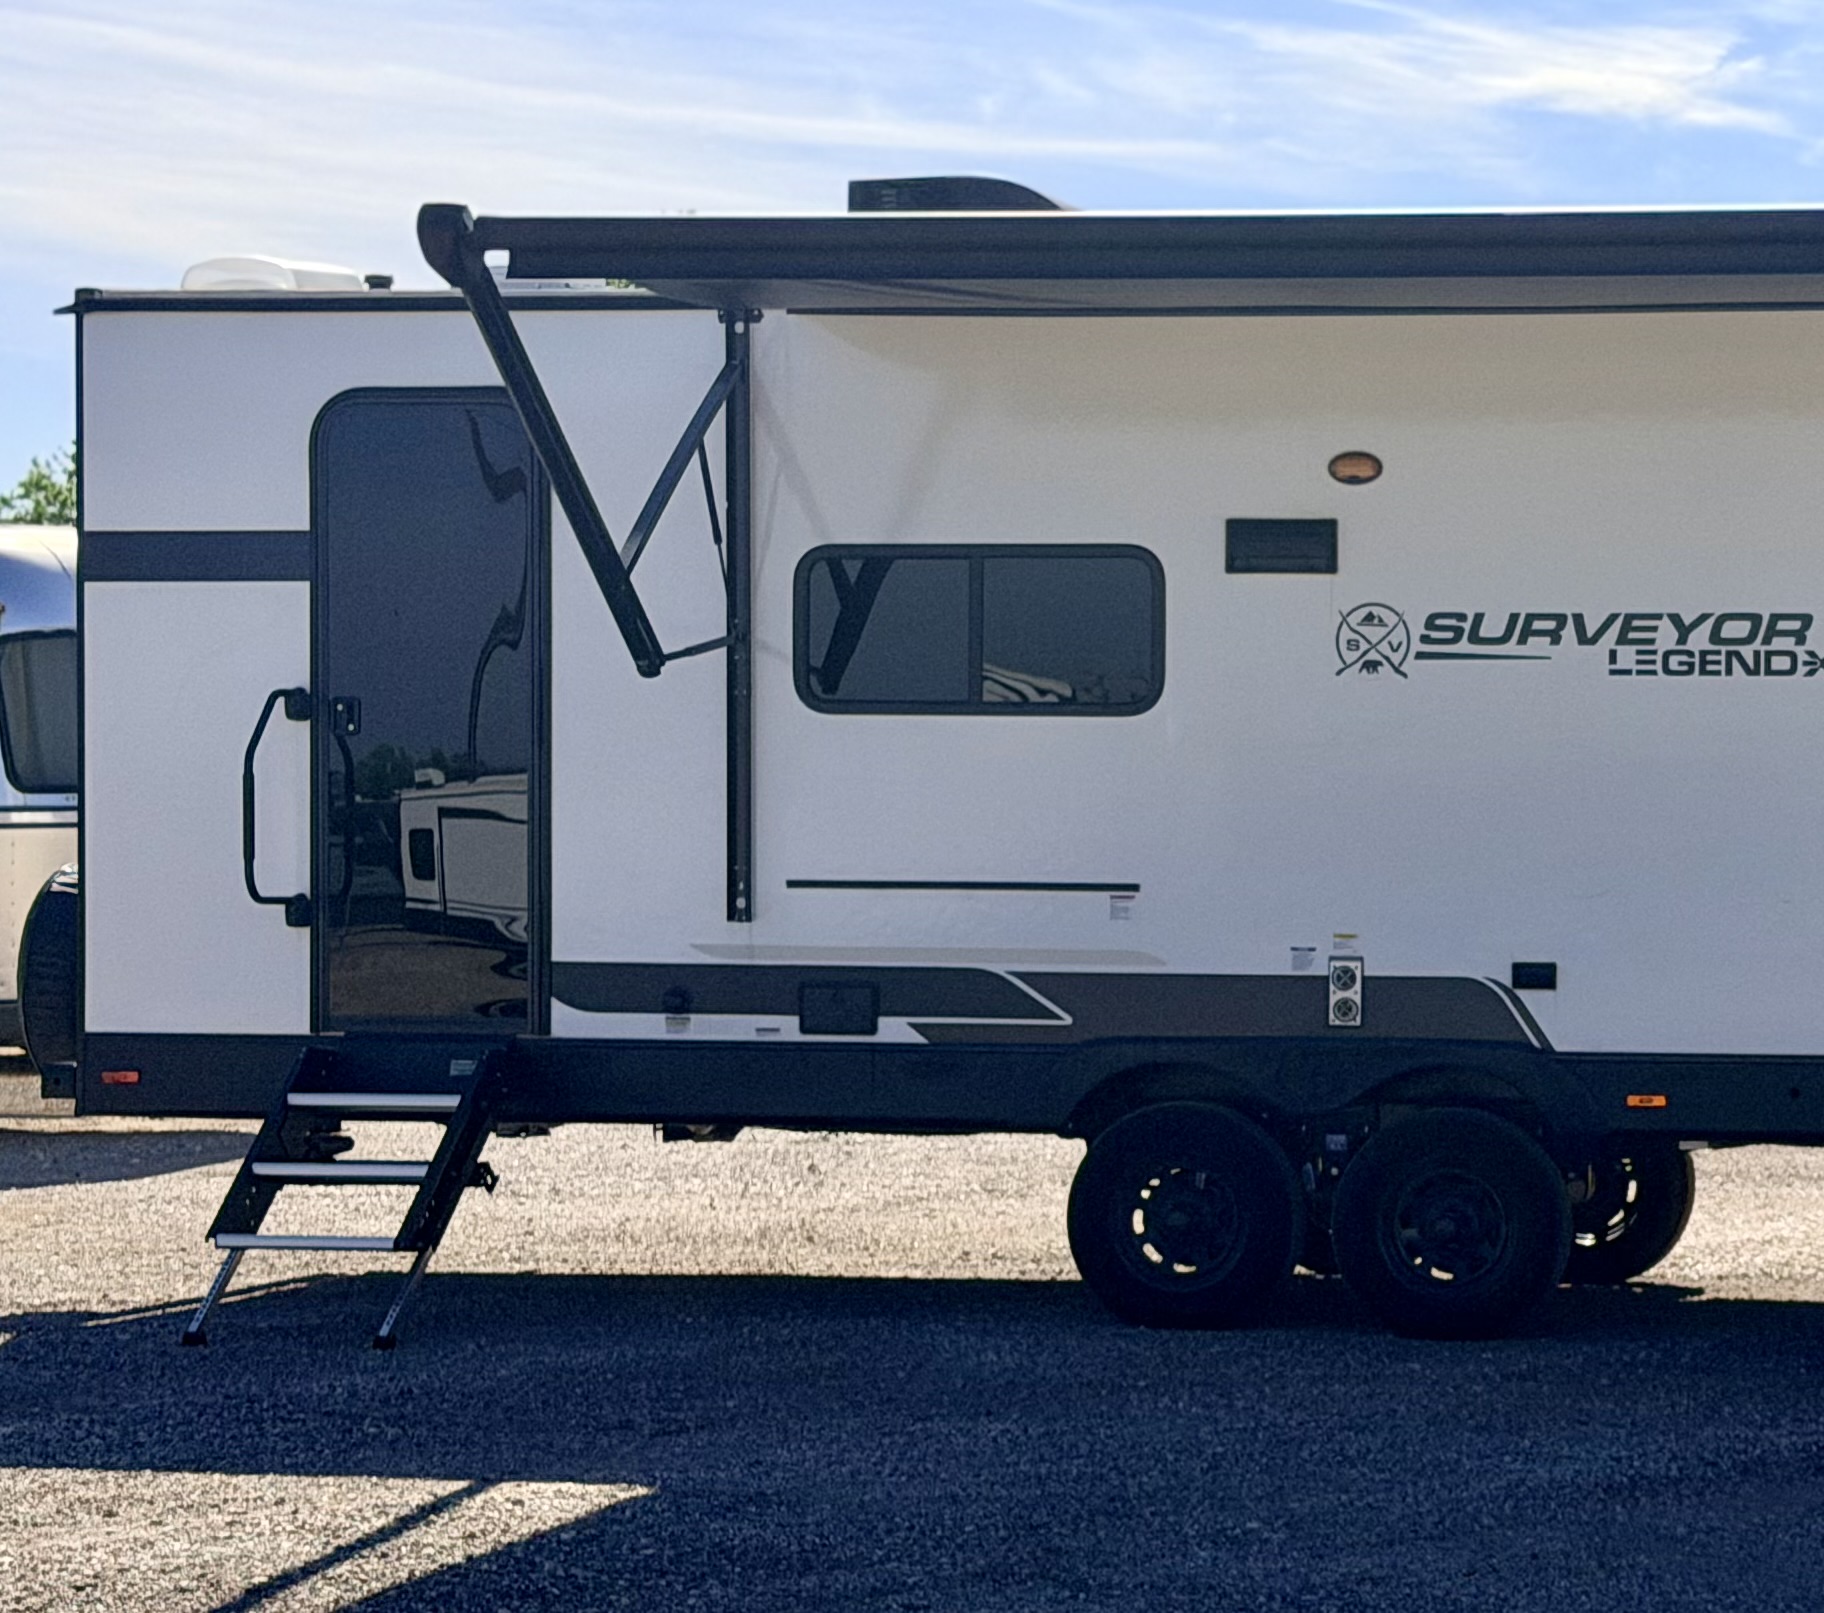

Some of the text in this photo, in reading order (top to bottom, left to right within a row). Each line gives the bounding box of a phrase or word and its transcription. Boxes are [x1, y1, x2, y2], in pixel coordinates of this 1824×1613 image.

[1419, 612, 1814, 646] SURVEYOR
[1346, 638, 1403, 653] S V
